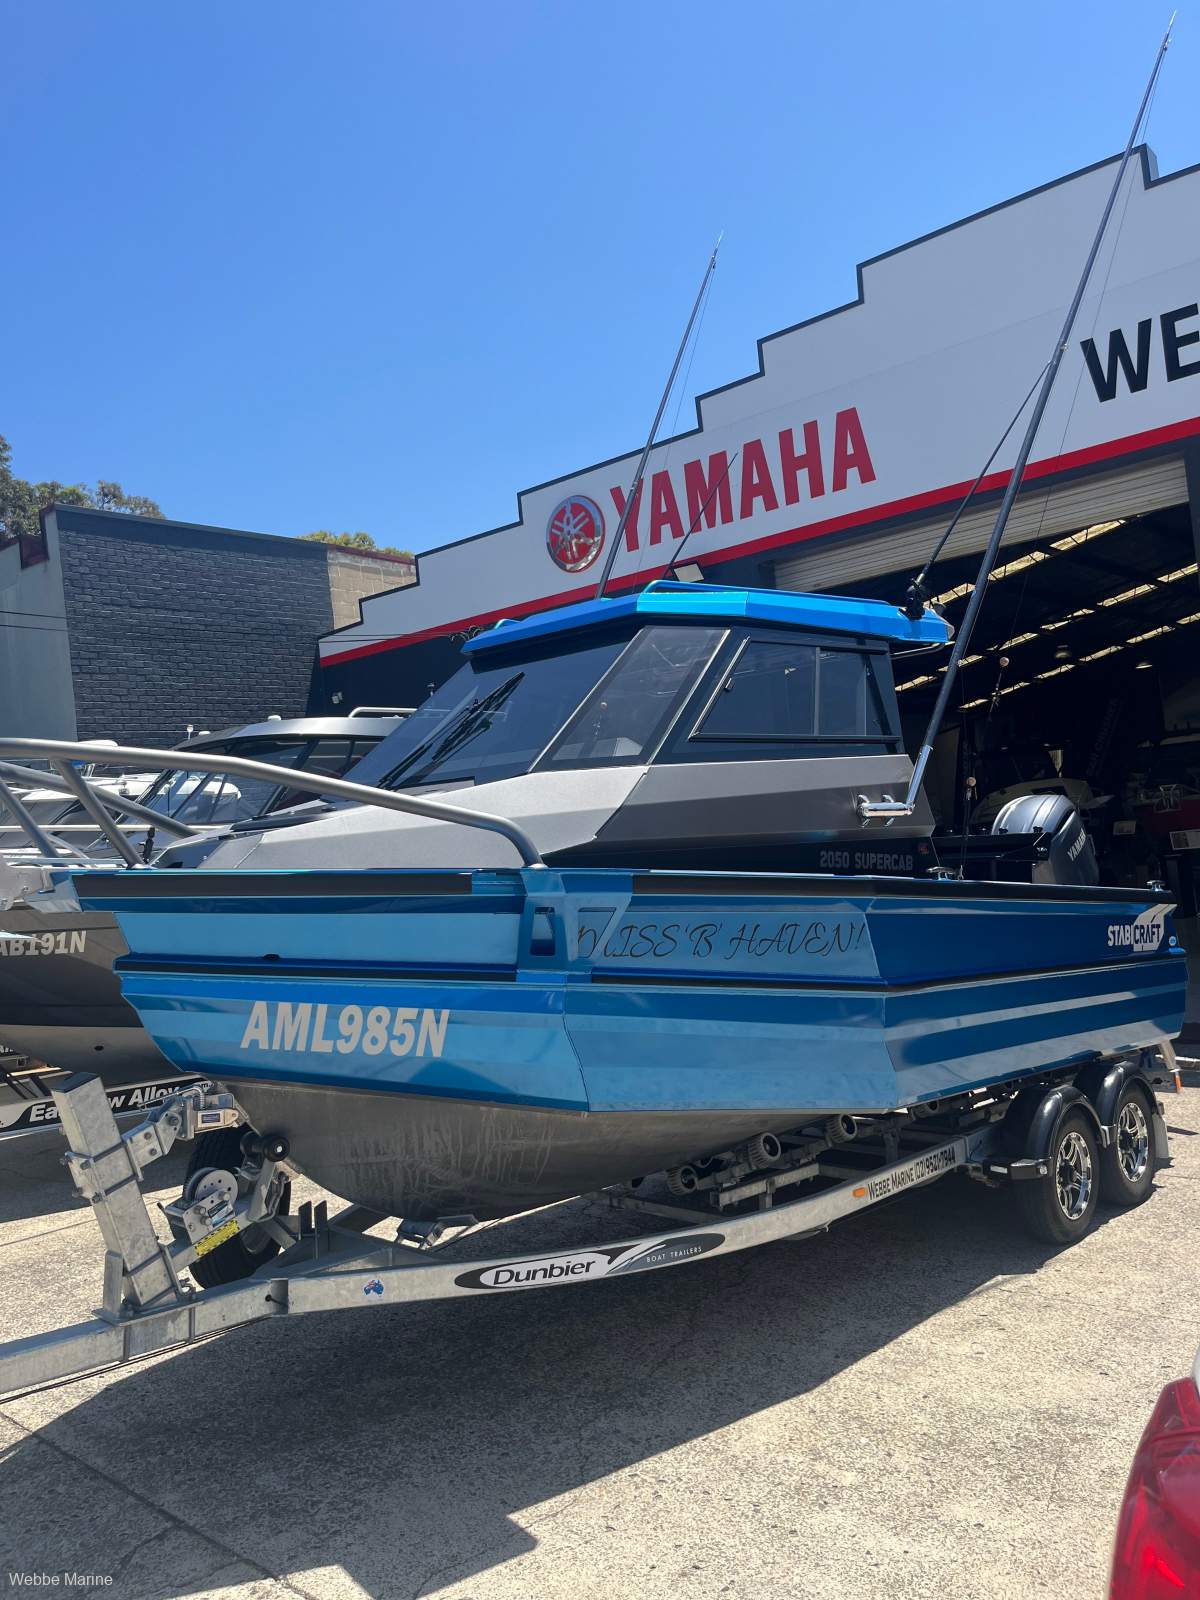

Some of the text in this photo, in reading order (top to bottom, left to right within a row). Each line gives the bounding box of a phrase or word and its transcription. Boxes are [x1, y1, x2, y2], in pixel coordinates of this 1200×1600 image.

[1080, 303, 1200, 403] WE
[610, 407, 876, 552] YAMAHA
[820, 850, 913, 871] 2050 SUPERCAB
[1107, 924, 1161, 947] STABICRAFT
[240, 1000, 450, 1057] AML985N
[493, 1246, 702, 1286] Dunbier BOAT TRAILERS
